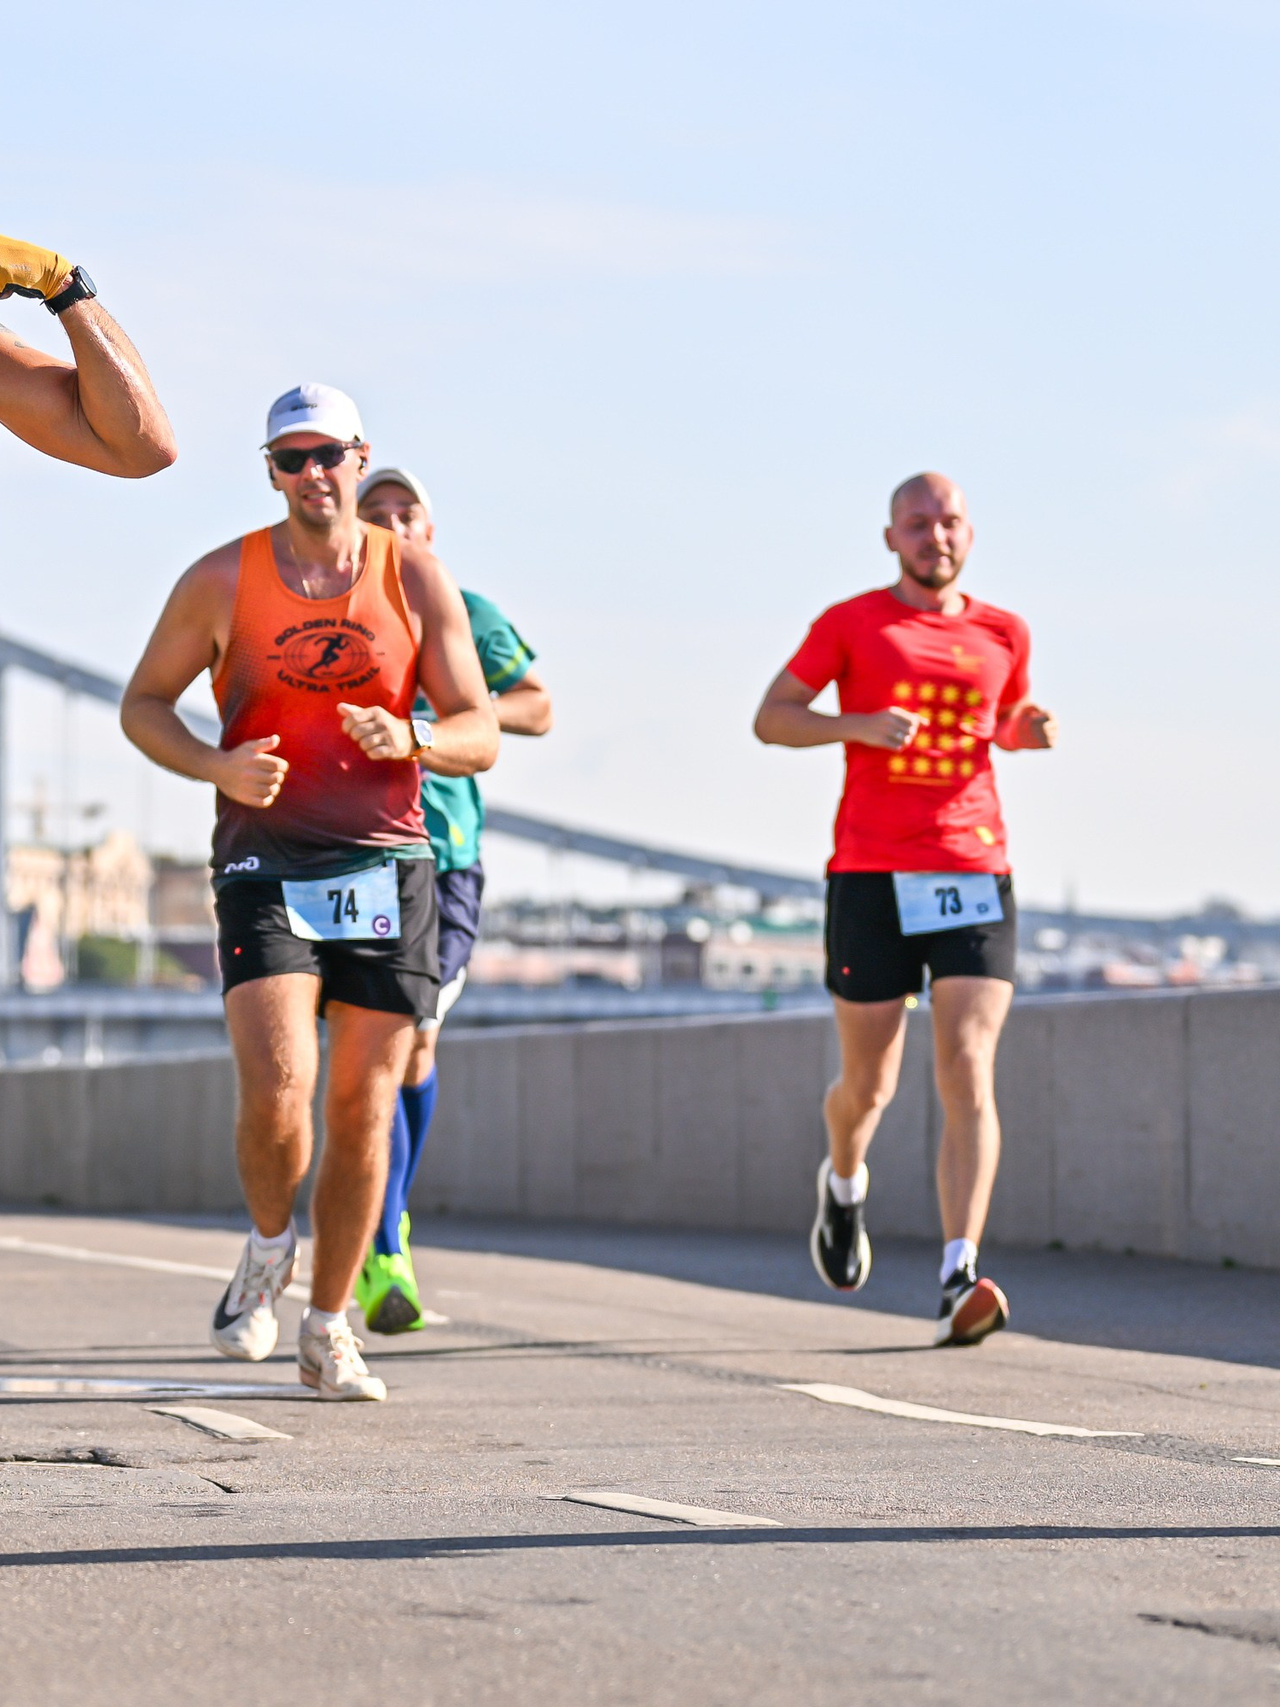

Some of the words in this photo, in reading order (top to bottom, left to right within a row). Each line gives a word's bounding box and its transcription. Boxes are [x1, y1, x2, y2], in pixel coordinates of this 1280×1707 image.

[277, 669, 330, 692] ULTRA
[327, 888, 359, 924] 74
[935, 886, 962, 915] 73
